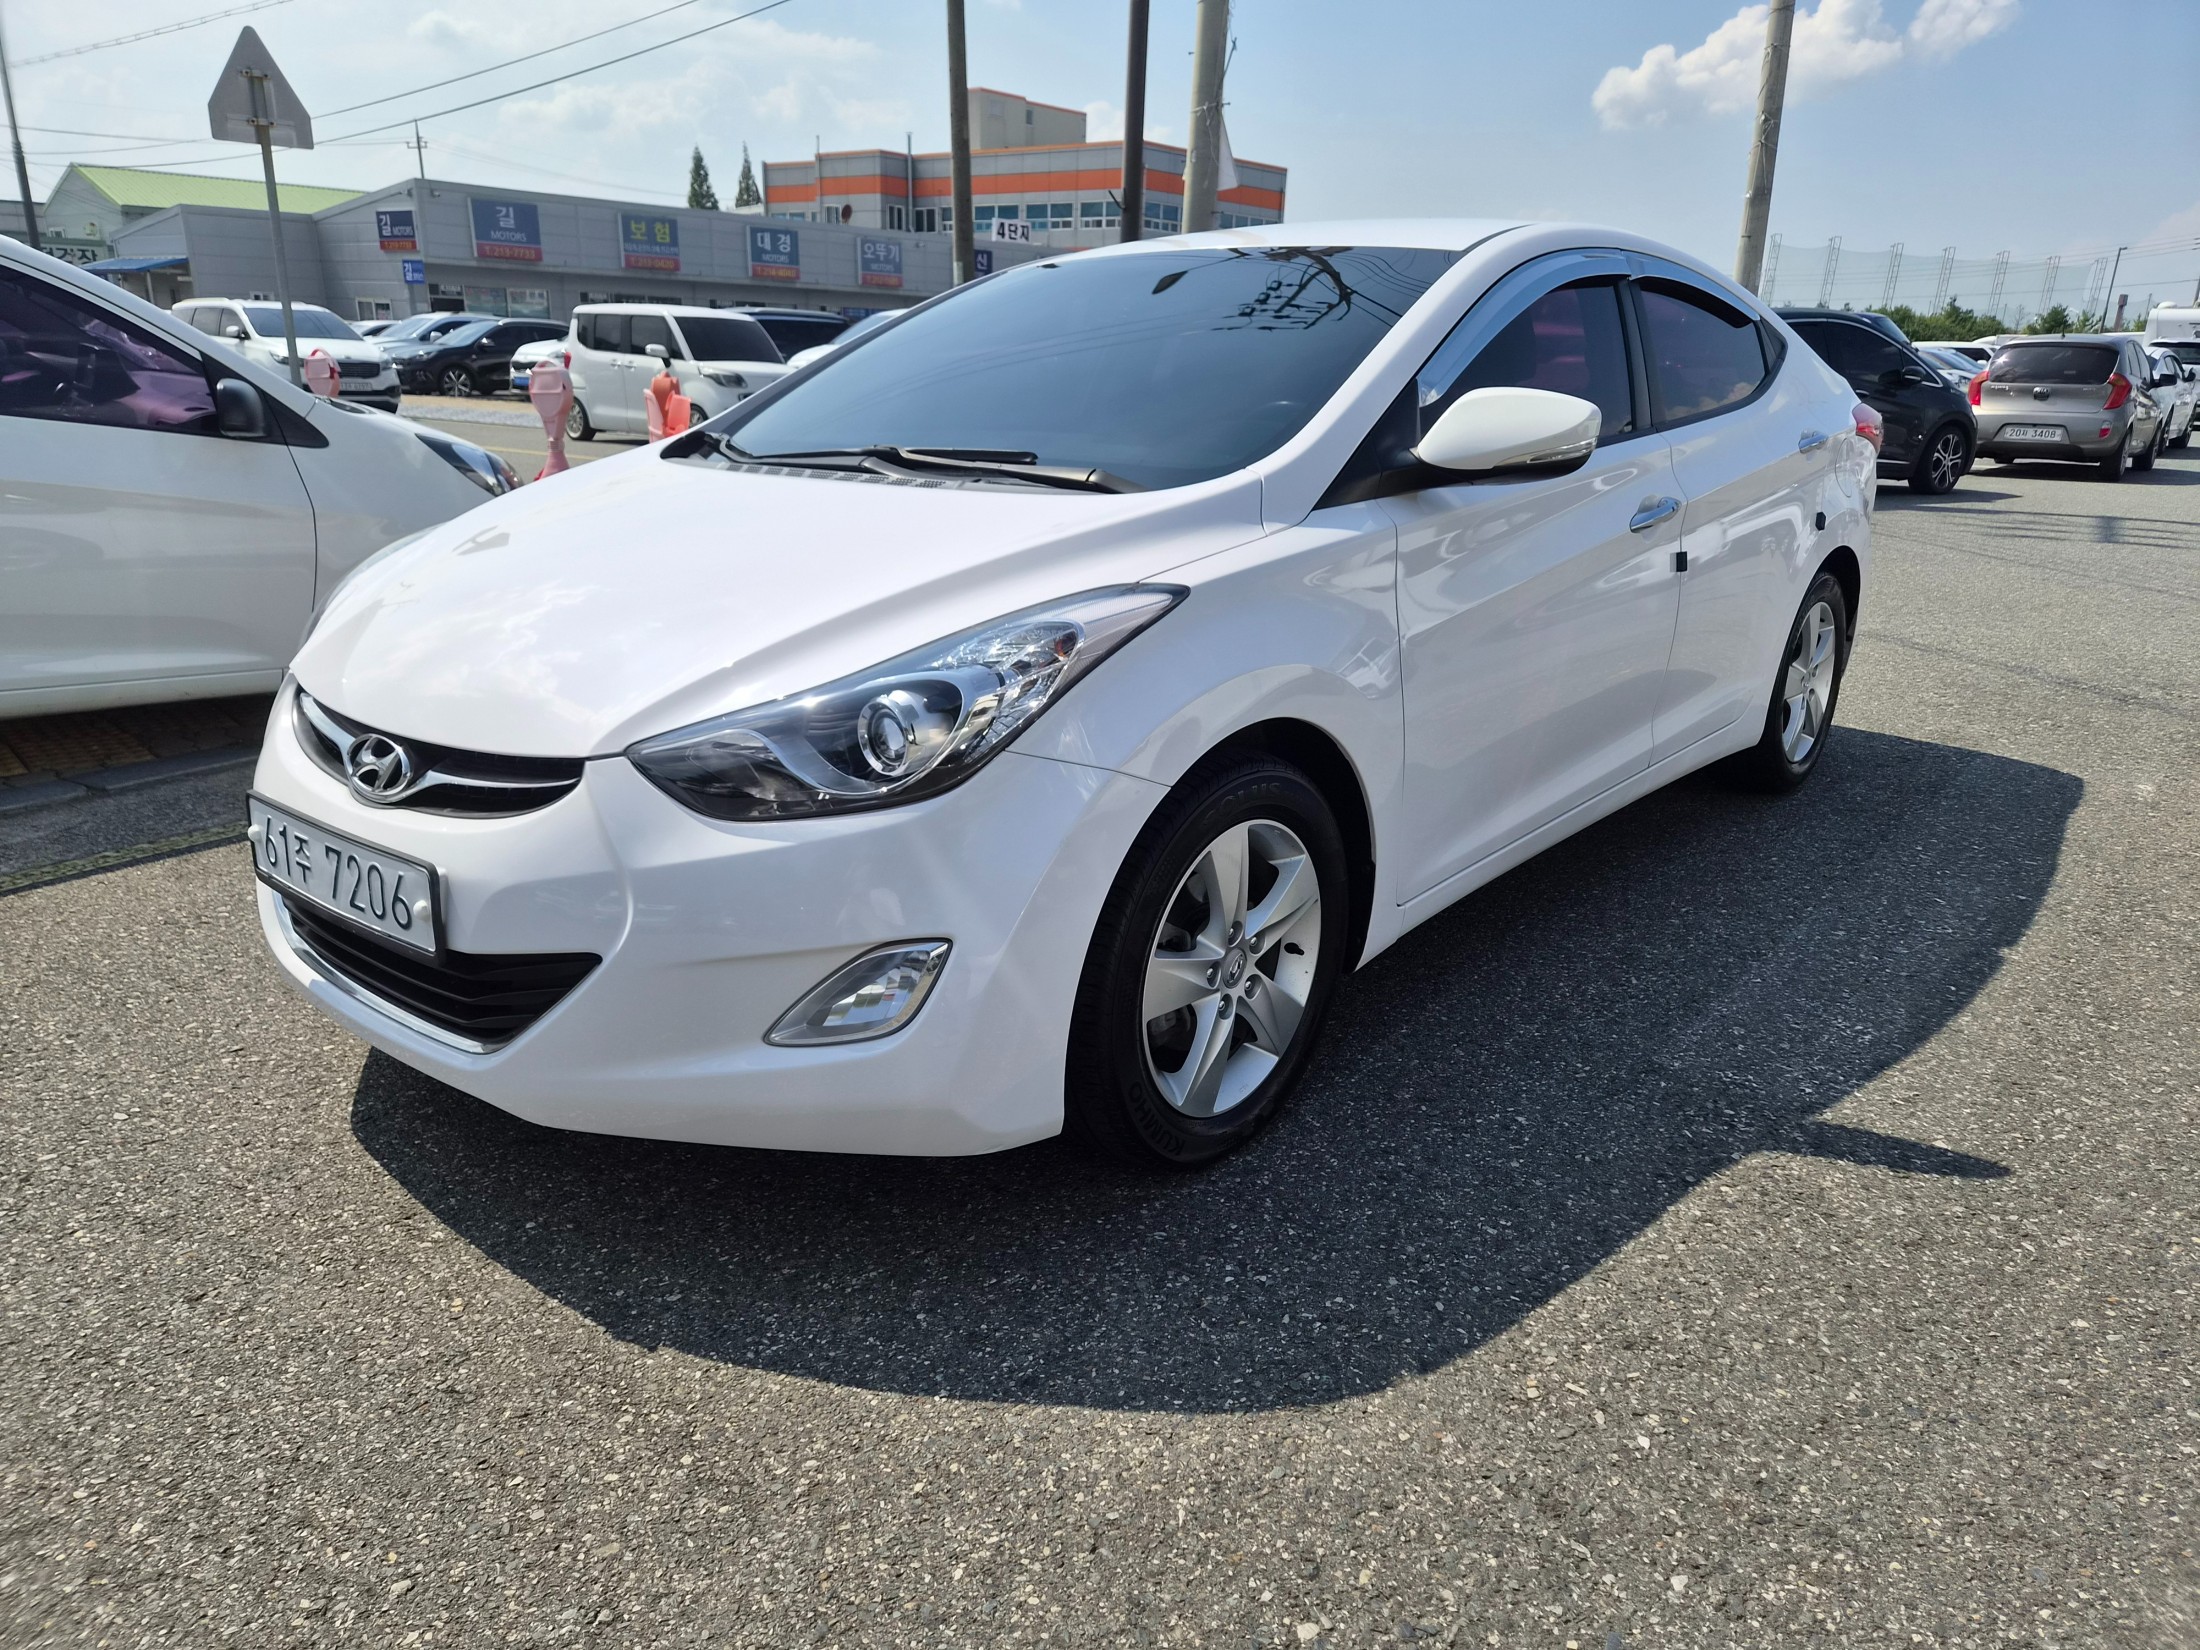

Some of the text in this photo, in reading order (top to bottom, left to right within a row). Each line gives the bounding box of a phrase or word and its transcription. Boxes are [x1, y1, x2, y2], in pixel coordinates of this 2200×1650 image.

[379, 213, 392, 236] 길
[495, 206, 516, 228] 길
[392, 225, 414, 236] MOTORS
[490, 230, 527, 242] MOTORS
[630, 219, 671, 243] 보험
[996, 221, 1029, 242] 4단지
[756, 231, 791, 253] 대경
[863, 242, 900, 263] 오뚜기
[762, 253, 789, 263] MOTORS
[870, 263, 895, 273] MOTORS
[403, 261, 413, 281] 길
[2031, 429, 2057, 439] 3408
[265, 815, 412, 930] 61주 7206
[1128, 1081, 1185, 1156] KUMHO
